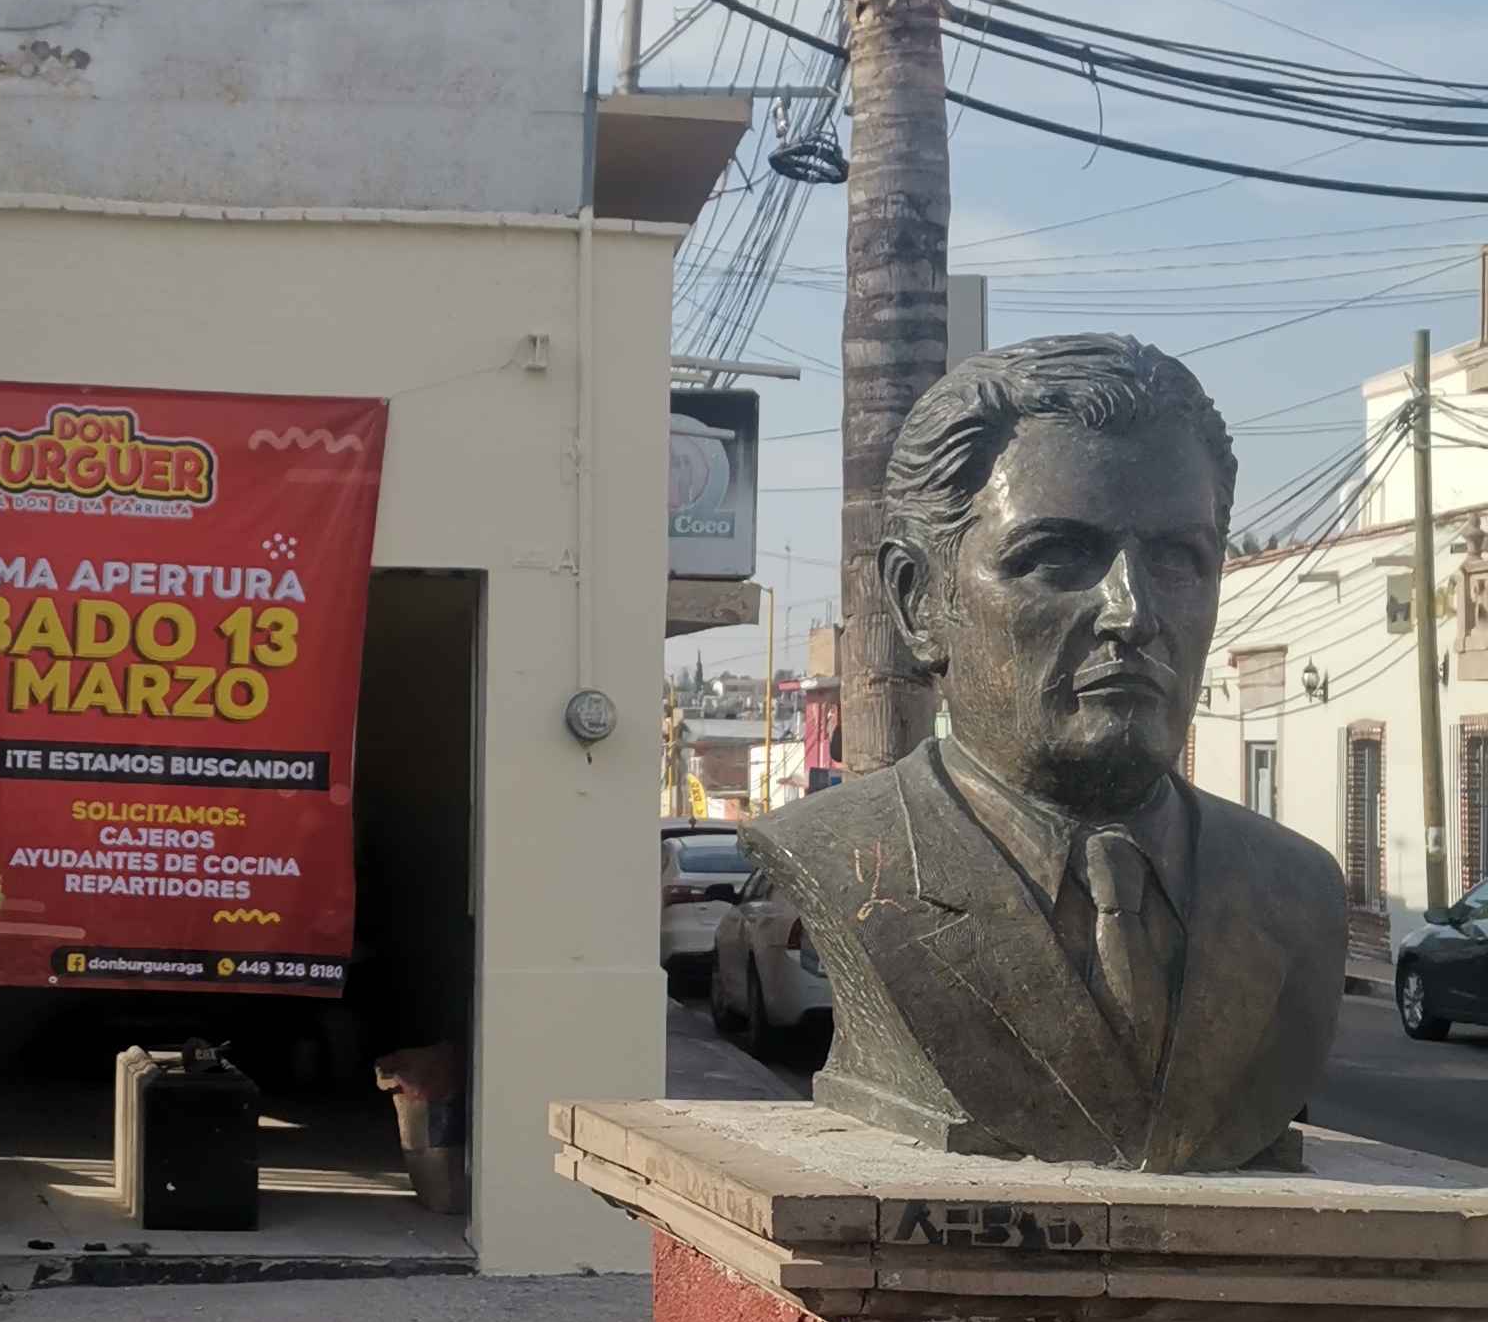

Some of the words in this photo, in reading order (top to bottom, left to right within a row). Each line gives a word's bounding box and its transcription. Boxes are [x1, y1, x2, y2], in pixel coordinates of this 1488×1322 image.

[56, 416, 125, 444] DON
[14, 497, 50, 509] DON
[56, 499, 76, 511] DE
[82, 500, 104, 512] LA
[111, 502, 191, 516] PARRILLA
[66, 559, 307, 603] APERTURA
[217, 605, 300, 667] 13
[11, 657, 270, 721] MARZO
[5, 748, 43, 769] ¡TE
[48, 751, 164, 774] ESTAMOS
[170, 756, 315, 781] BUSCANDO!
[71, 800, 246, 826] SOLICITAMOS:
[98, 826, 216, 849] CAJEROS
[9, 847, 159, 872] AYUDANTES
[164, 853, 198, 873] DE
[202, 854, 301, 877] COCINA
[64, 873, 251, 900] REPARTIDORES
[87, 955, 204, 975] donburguerags
[236, 960, 270, 975] 449
